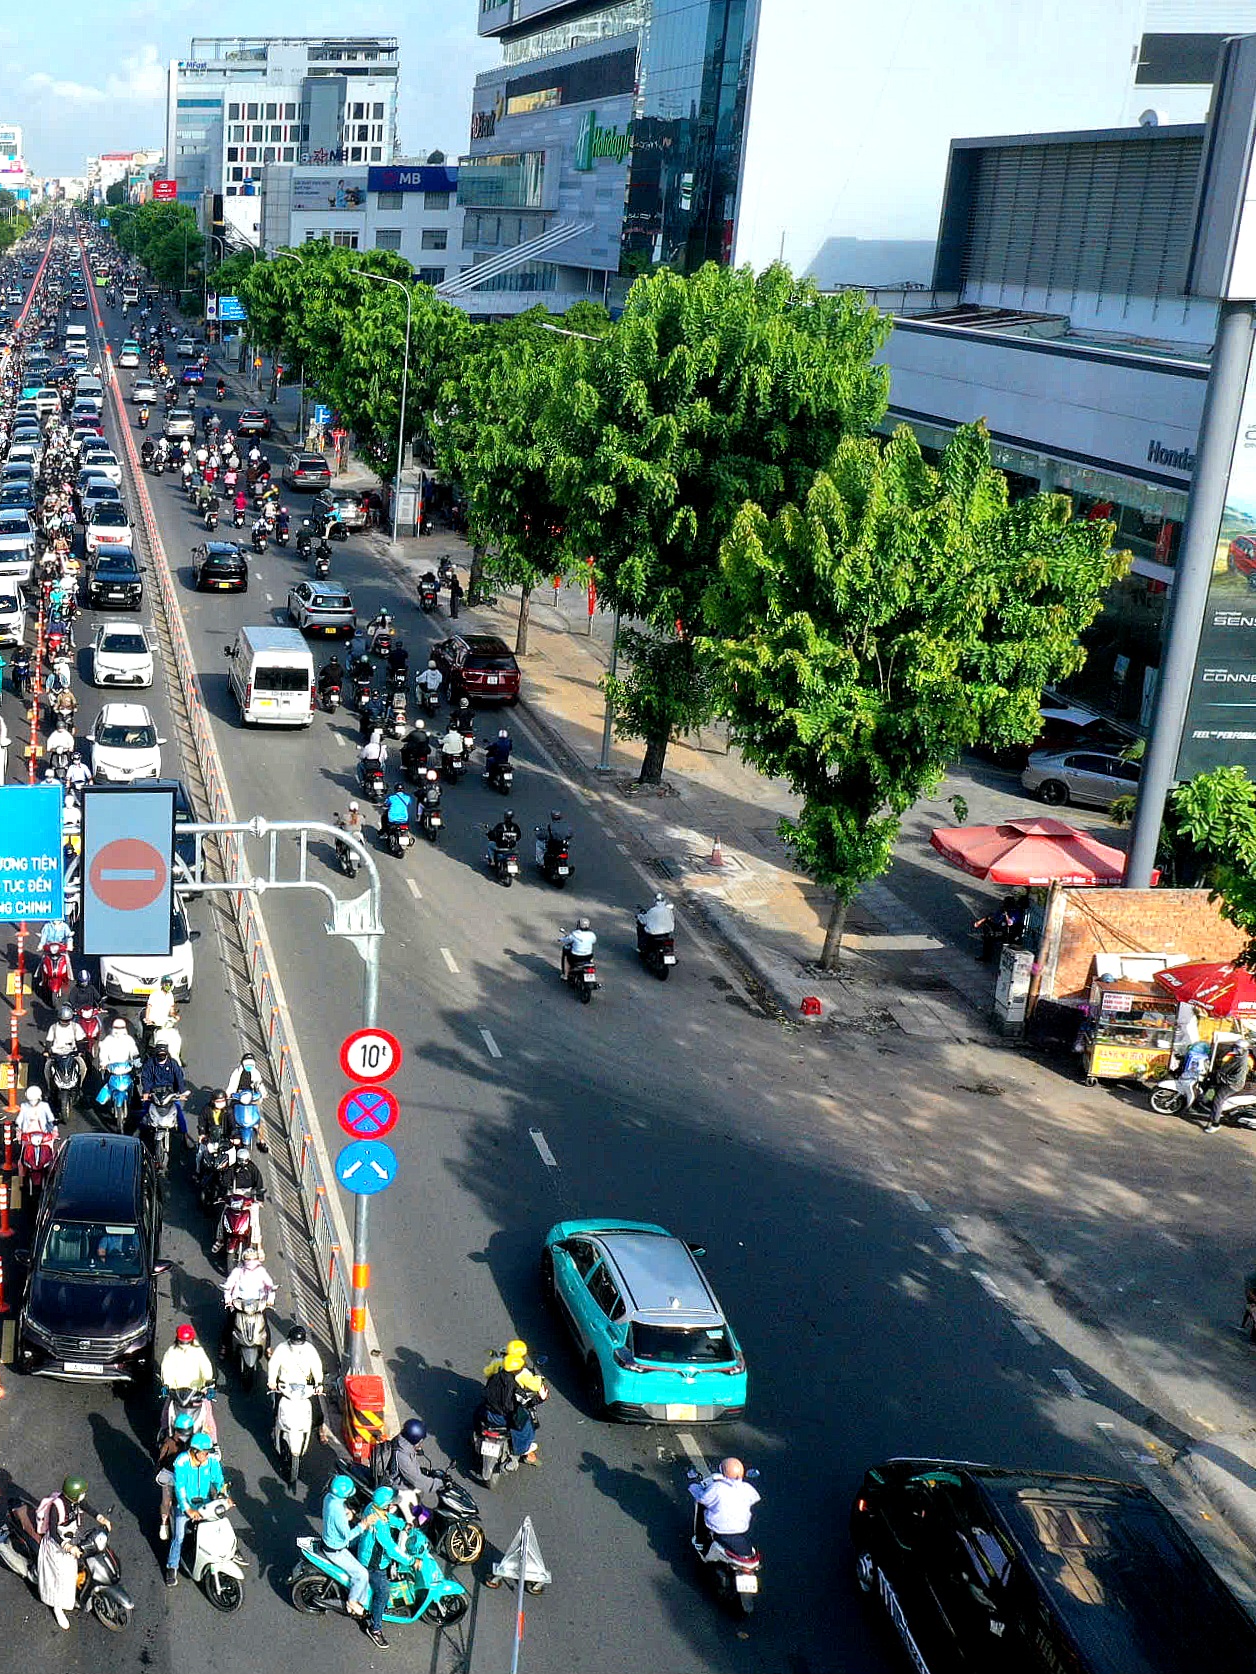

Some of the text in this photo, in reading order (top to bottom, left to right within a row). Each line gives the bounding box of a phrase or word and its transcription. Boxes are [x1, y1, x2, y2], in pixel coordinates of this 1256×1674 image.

[592, 125, 626, 165] Holiday
[399, 172, 422, 185] MB
[1214, 617, 1256, 626] SEN
[1192, 731, 1210, 739] FEEL
[28, 874, 52, 892] ĐẾN
[15, 900, 52, 914] CHINH
